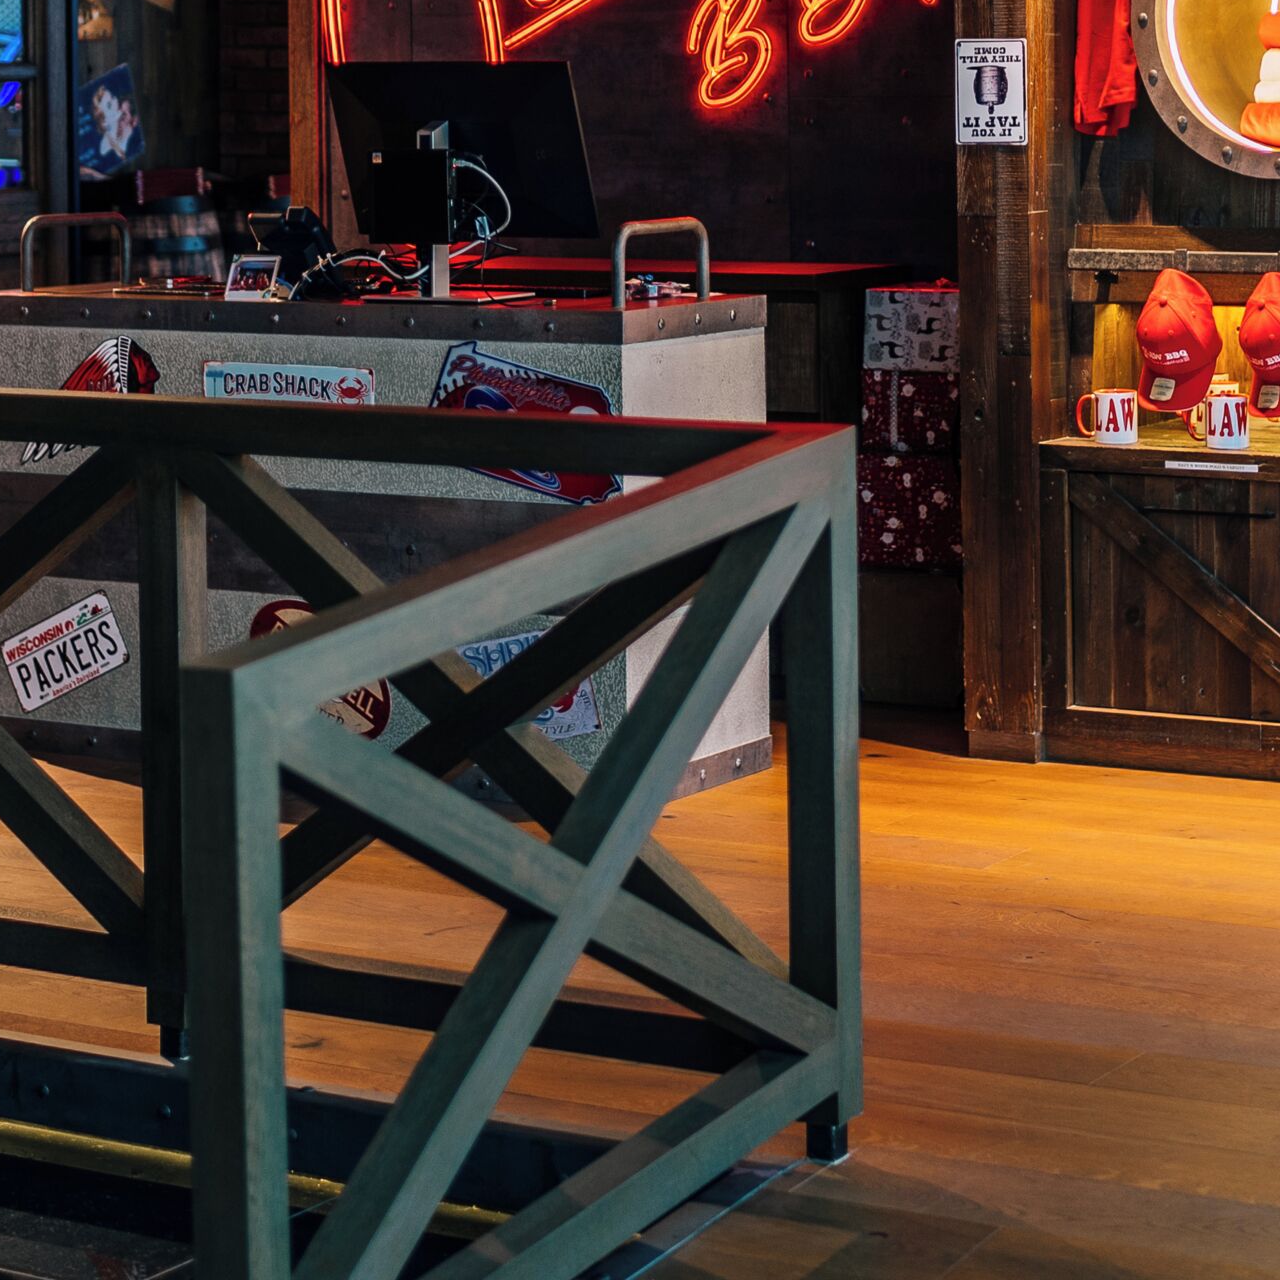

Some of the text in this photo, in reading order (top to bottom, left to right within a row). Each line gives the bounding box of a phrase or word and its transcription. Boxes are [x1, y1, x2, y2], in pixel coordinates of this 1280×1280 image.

[973, 46, 1007, 55] COME
[959, 55, 1022, 64] THEY WILL
[962, 116, 1021, 128] TAP IT
[971, 128, 996, 137] YOU
[1164, 349, 1189, 361] BBQ
[222, 372, 332, 403] CRAB SHACK
[5, 621, 66, 662] WISCONSIN
[16, 620, 120, 699] PACKERS
